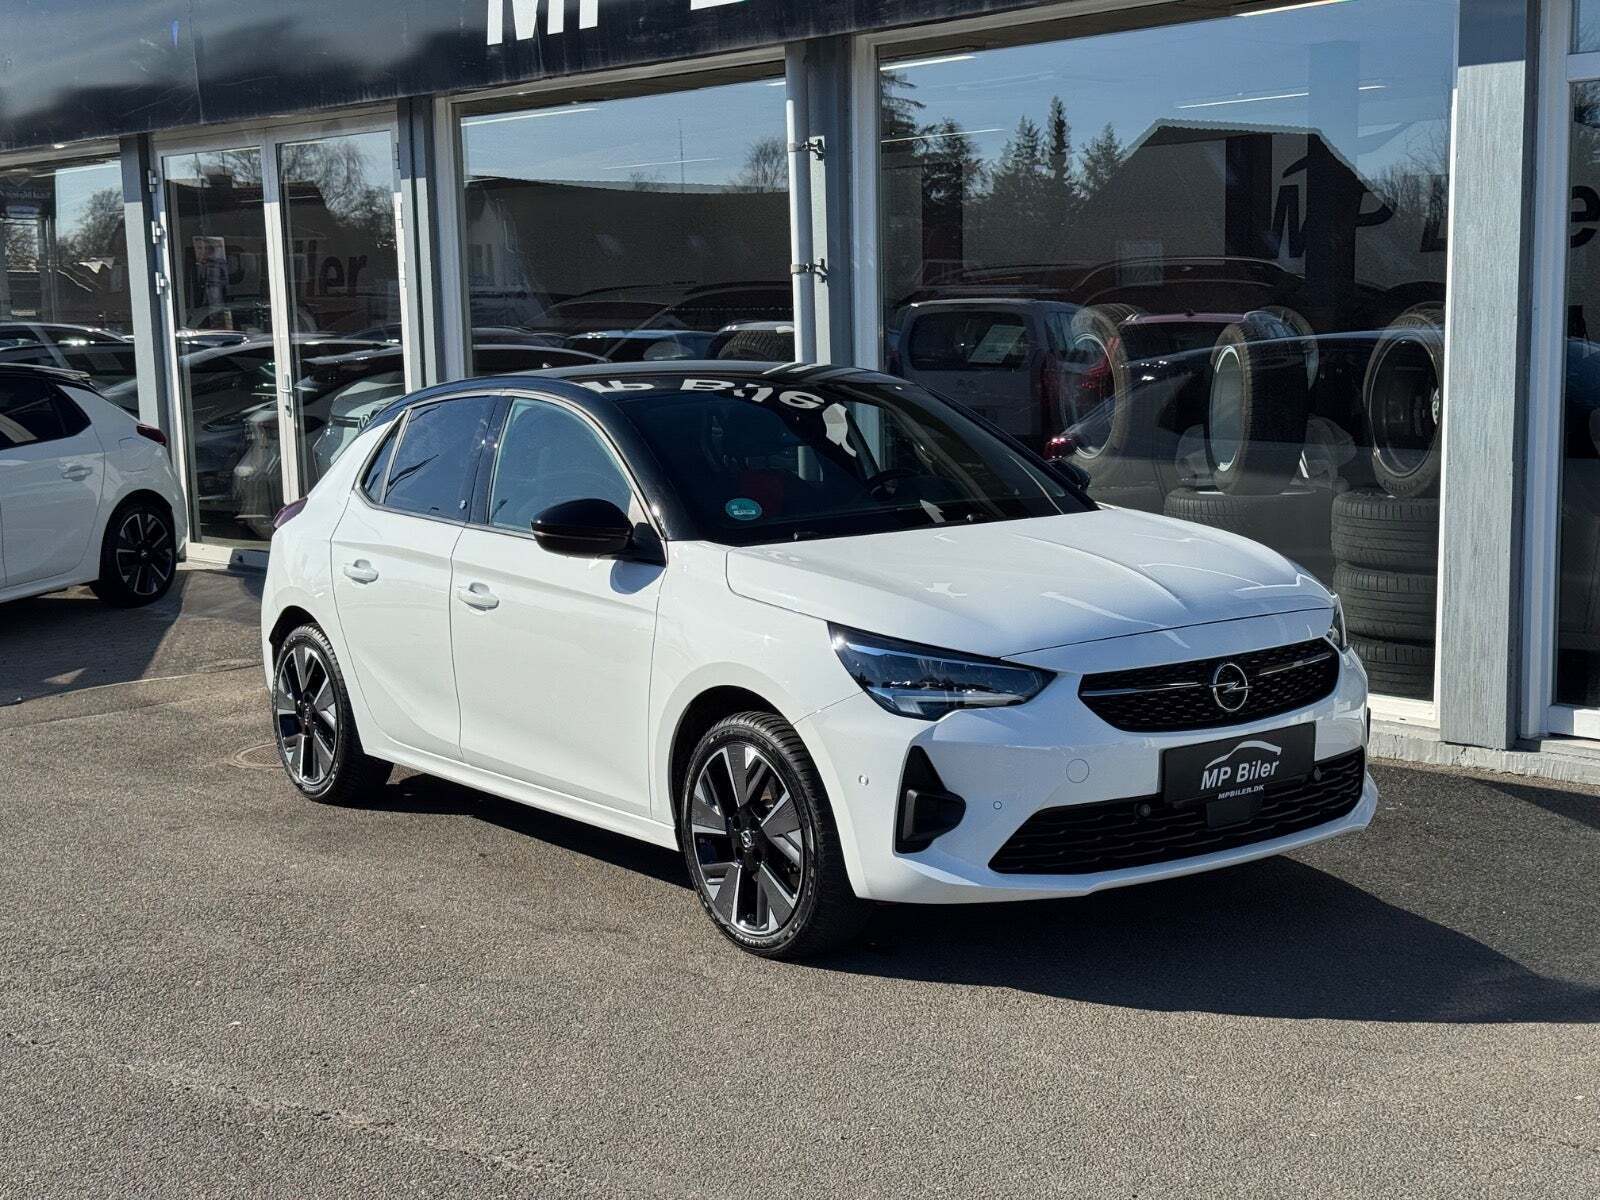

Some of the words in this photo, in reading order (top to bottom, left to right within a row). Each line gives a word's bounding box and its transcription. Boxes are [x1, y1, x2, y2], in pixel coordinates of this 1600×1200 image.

[1200, 766, 1231, 790] MP
[1236, 760, 1280, 783] Biler
[1217, 784, 1264, 799] MPBILER.DK
